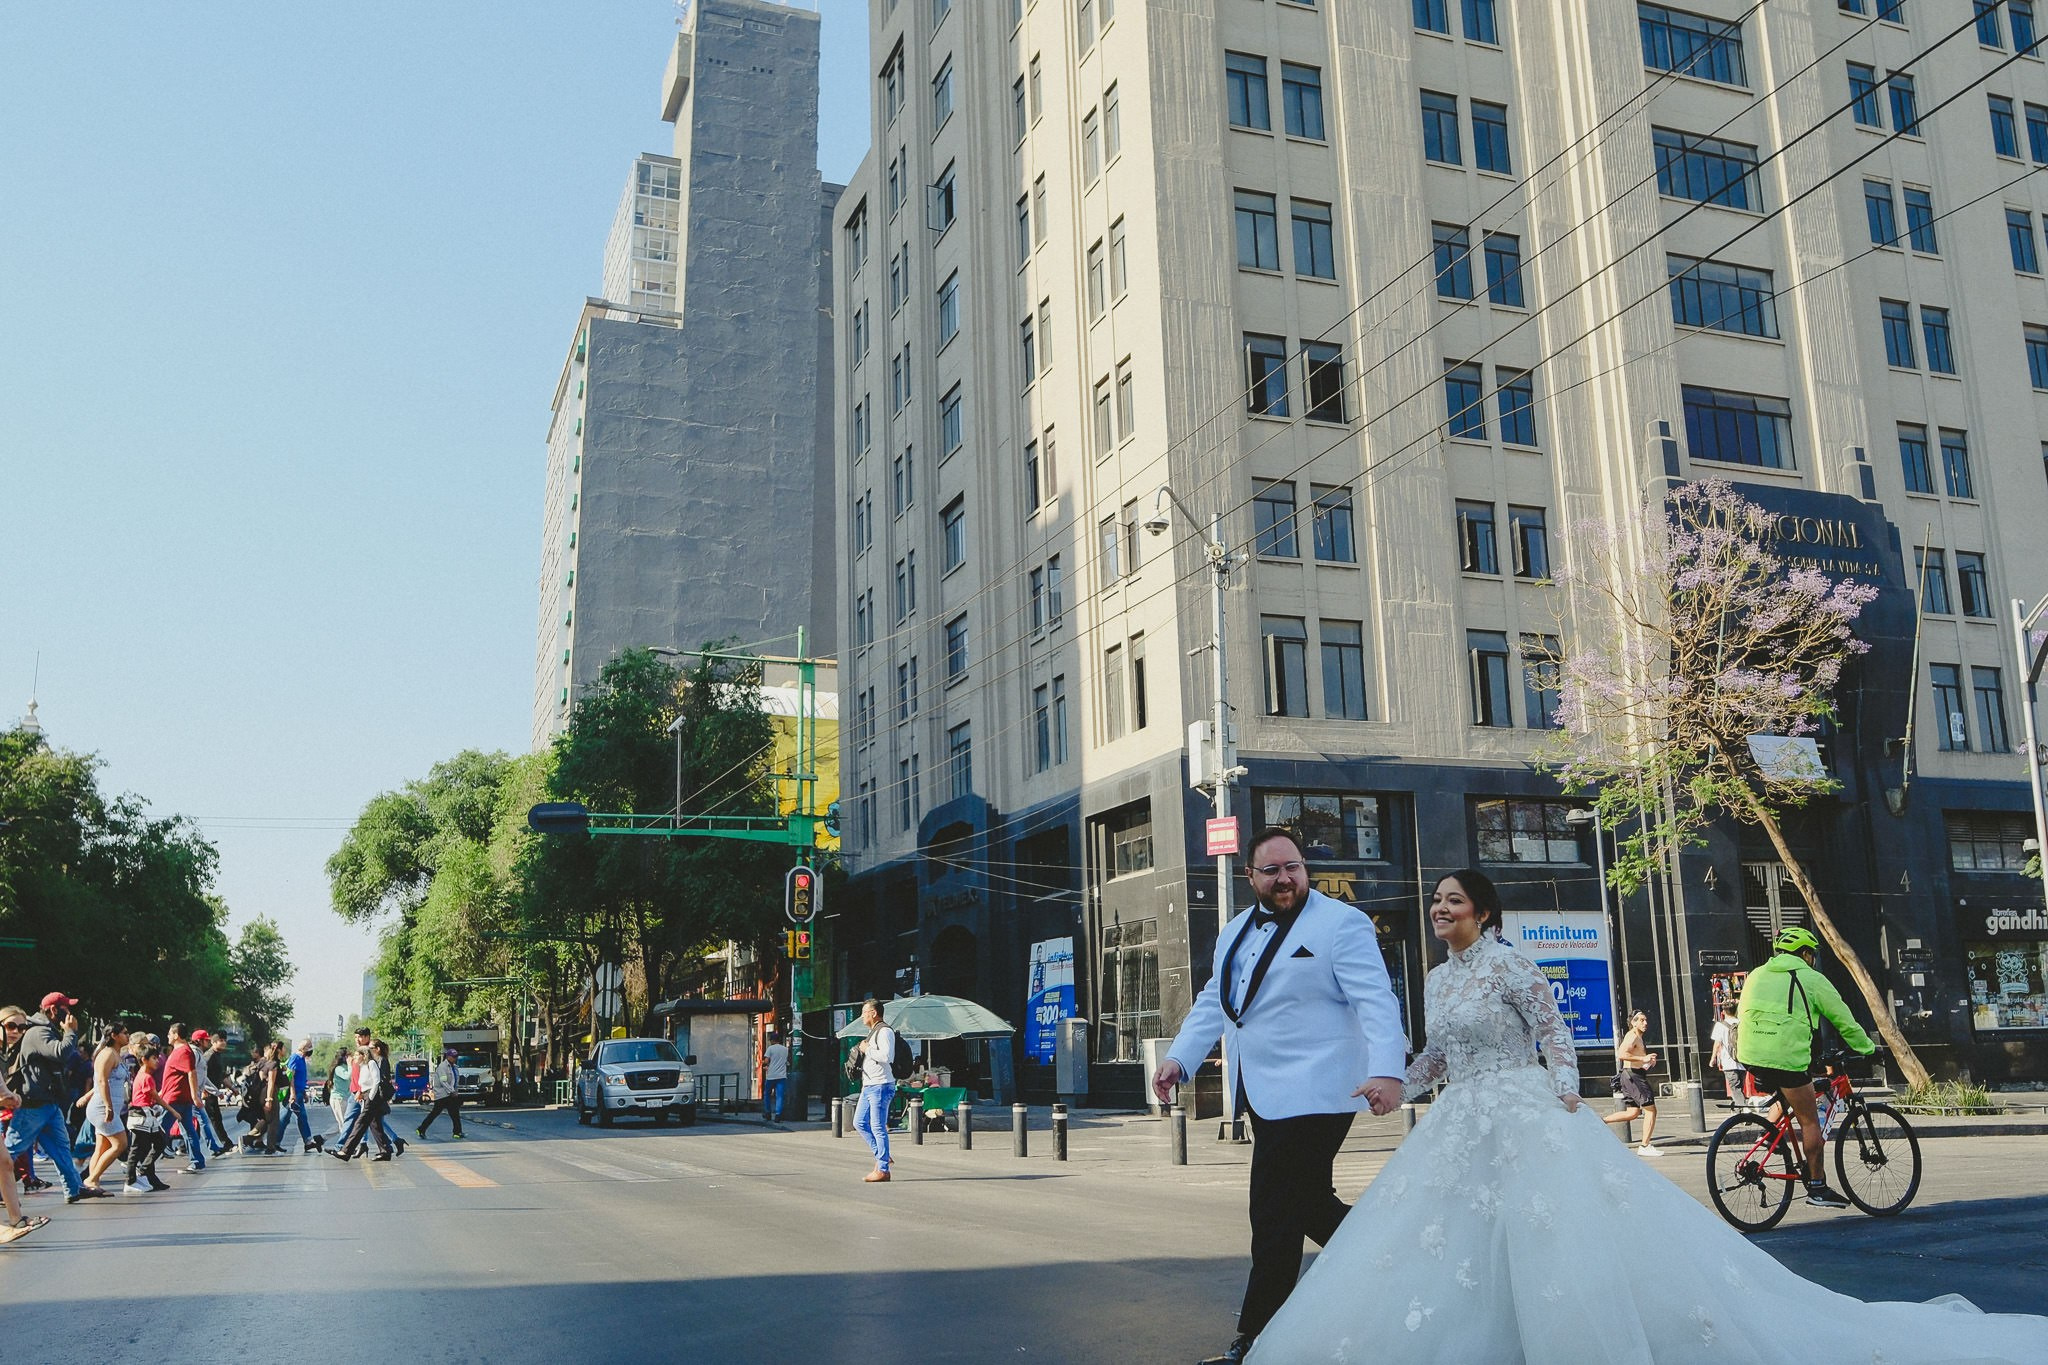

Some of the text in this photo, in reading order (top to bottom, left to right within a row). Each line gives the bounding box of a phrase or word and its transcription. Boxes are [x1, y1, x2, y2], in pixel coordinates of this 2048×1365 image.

[1704, 865, 1718, 891] 4
[1900, 869, 1911, 893] 4
[1522, 925, 1598, 940] infinitum
[1985, 909, 2048, 935] gandhi
[1537, 941, 1560, 949] Exceso
[1569, 941, 1599, 949] Velocidad
